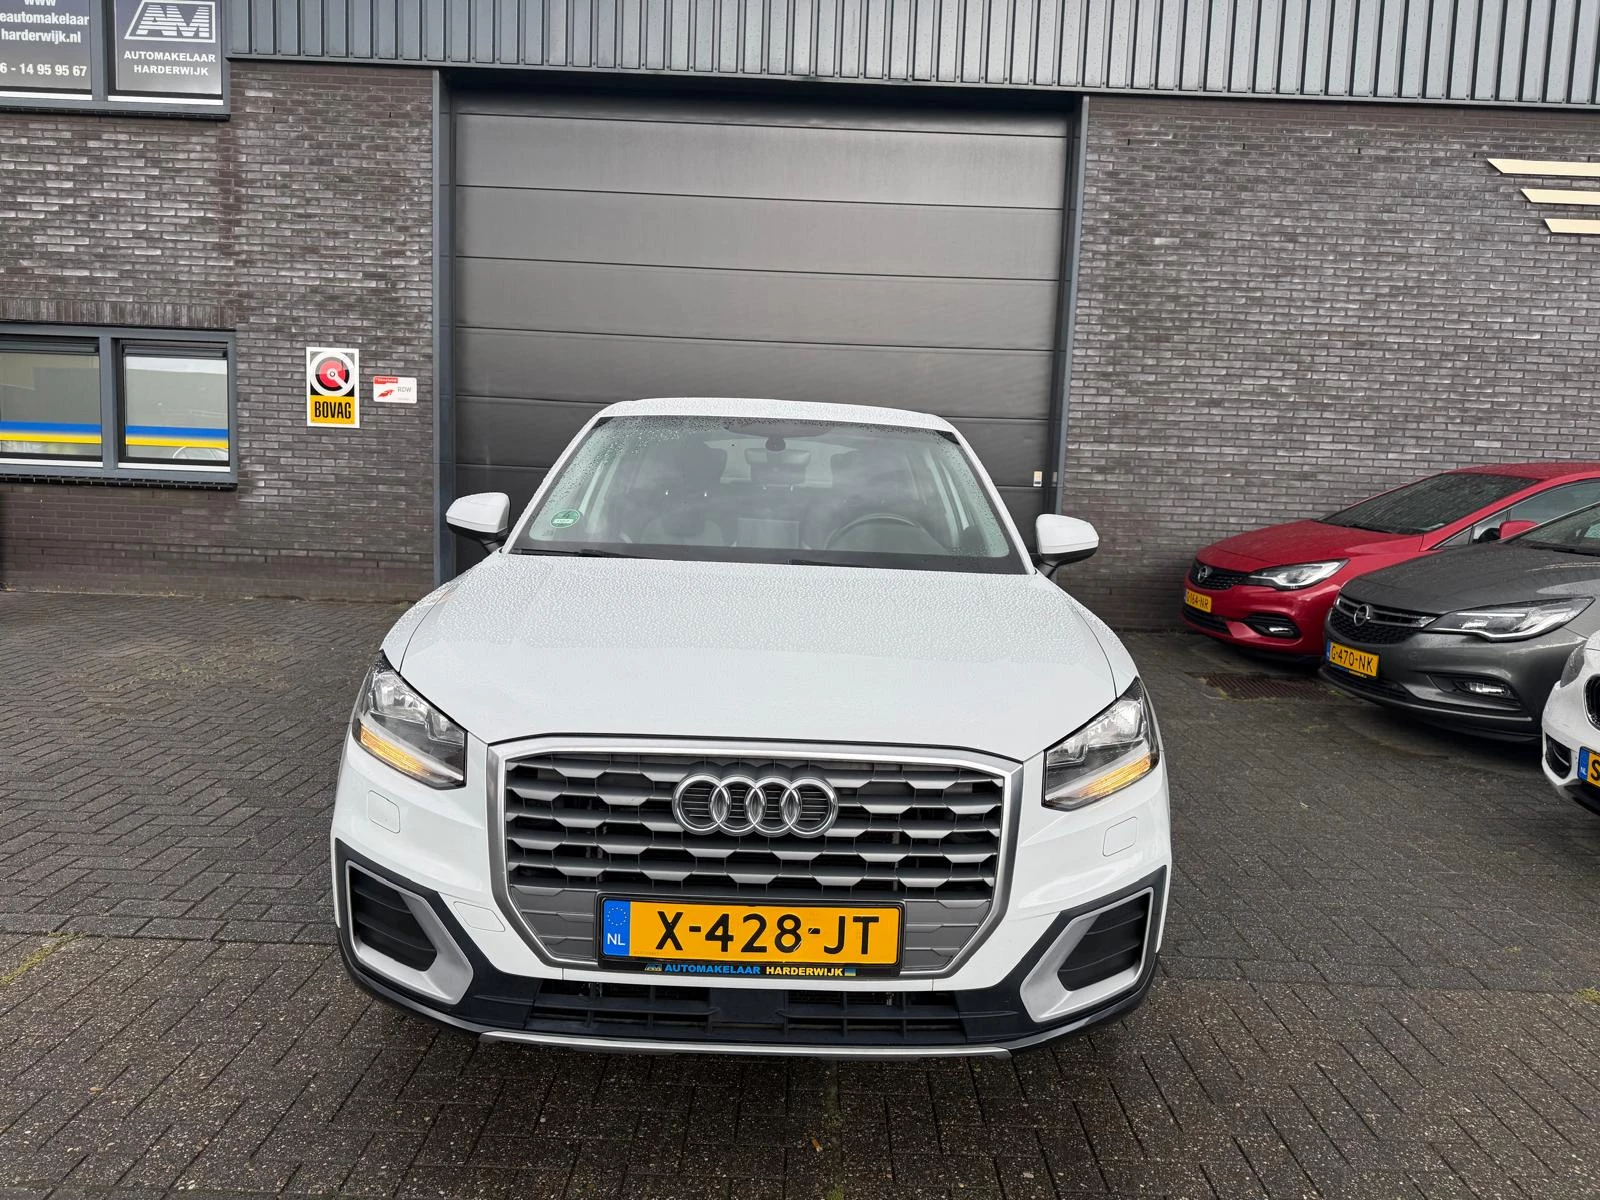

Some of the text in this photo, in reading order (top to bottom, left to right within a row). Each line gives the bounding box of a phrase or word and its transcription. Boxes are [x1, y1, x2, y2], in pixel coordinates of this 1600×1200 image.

[0, 11, 89, 26] eautomakelaar
[135, 5, 210, 38] AM
[1, 28, 81, 44] harderwijk.nl
[124, 51, 216, 63] AUTOMAKELAAR
[19, 63, 34, 75] 14
[37, 63, 51, 75] 95
[55, 64, 70, 76] 95
[72, 65, 87, 77] 67
[133, 65, 209, 76] HARDERWIJK
[314, 401, 352, 419] BOVAG
[1331, 645, 1374, 673] G-470-NK
[607, 932, 626, 946] NL
[655, 910, 880, 956] X-428-JT
[664, 963, 761, 975] AUTOMAKELAAR
[766, 966, 844, 977] HARDERWIJK
